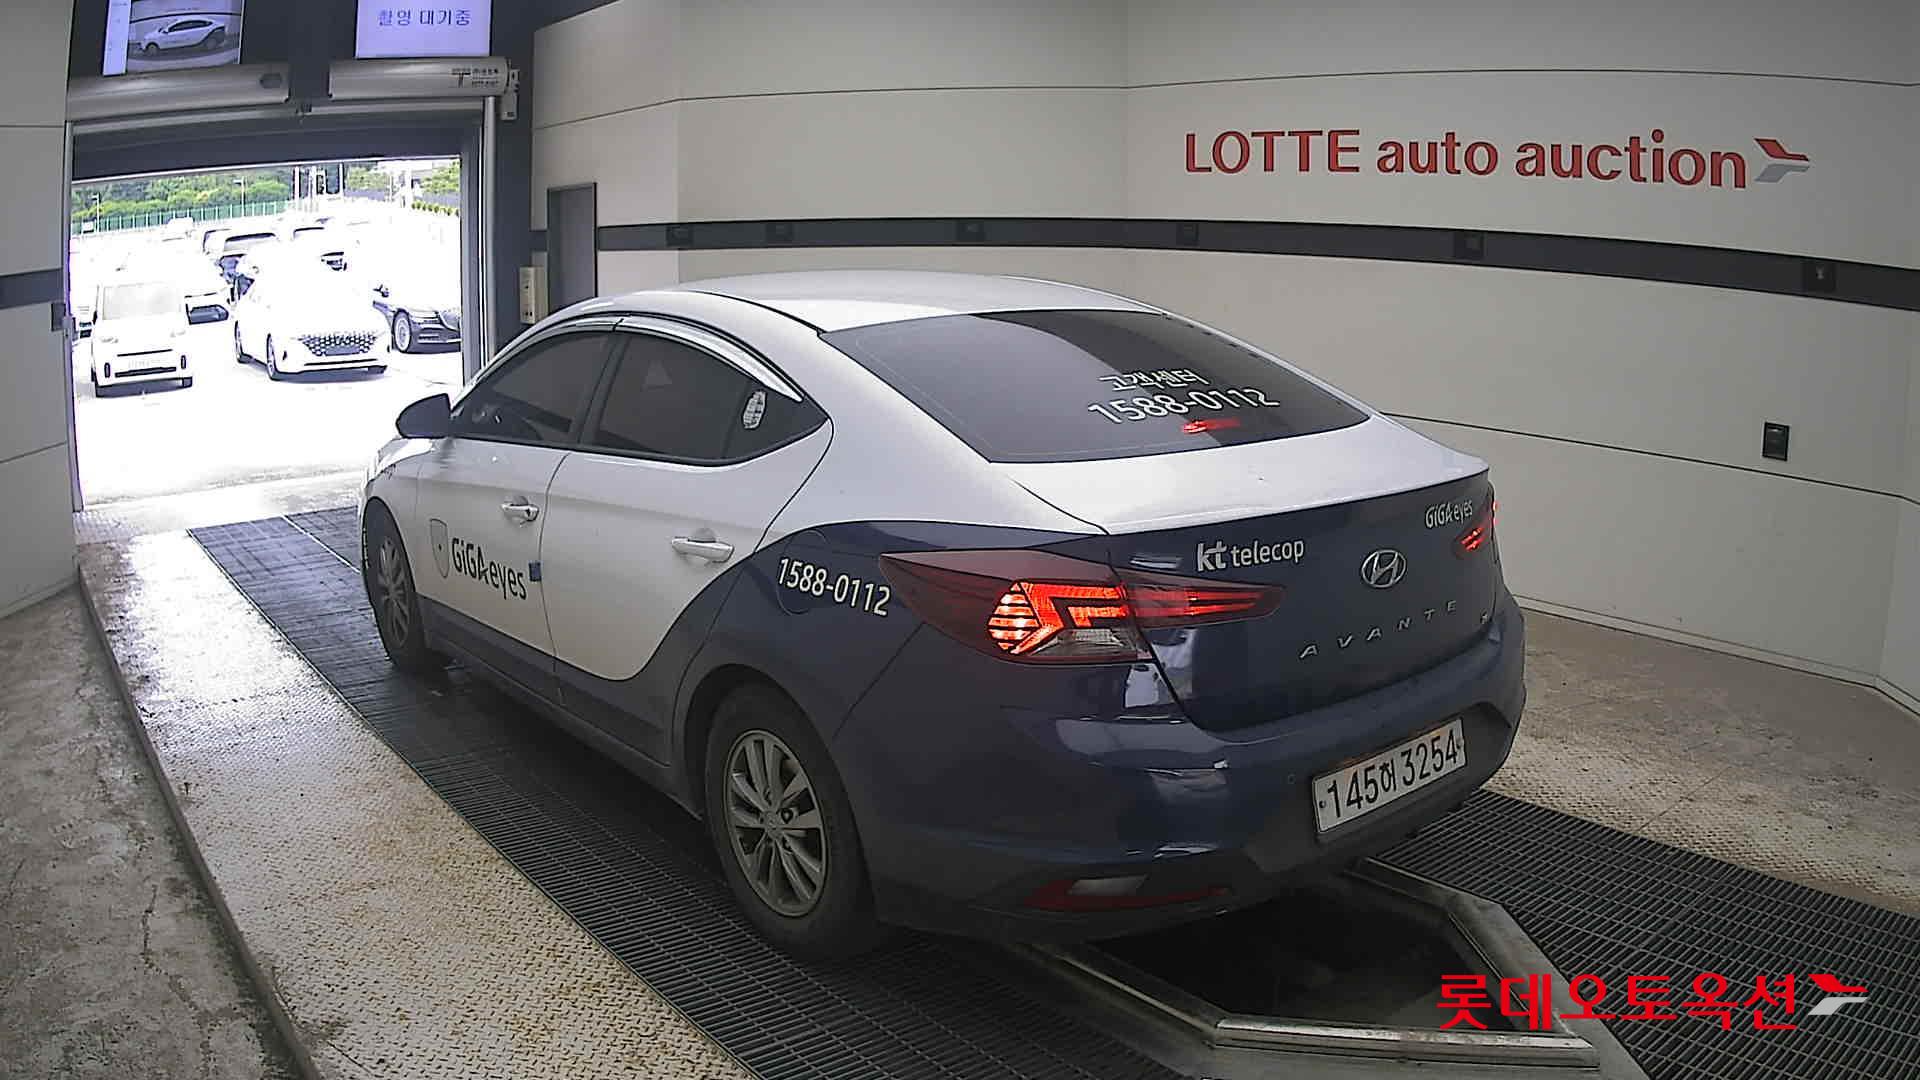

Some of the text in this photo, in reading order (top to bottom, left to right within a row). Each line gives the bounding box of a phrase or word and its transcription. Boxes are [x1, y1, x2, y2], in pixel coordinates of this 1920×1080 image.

[419, 9, 472, 27] 대기중
[1184, 128, 1747, 189] LOTTE auto auction
[1098, 368, 1210, 392] 고객센터
[1088, 387, 1281, 424] 1588-0112
[1196, 538, 1305, 572] kt telecop
[777, 557, 892, 617] 1588-0112
[1299, 600, 1457, 660] AVANTE
